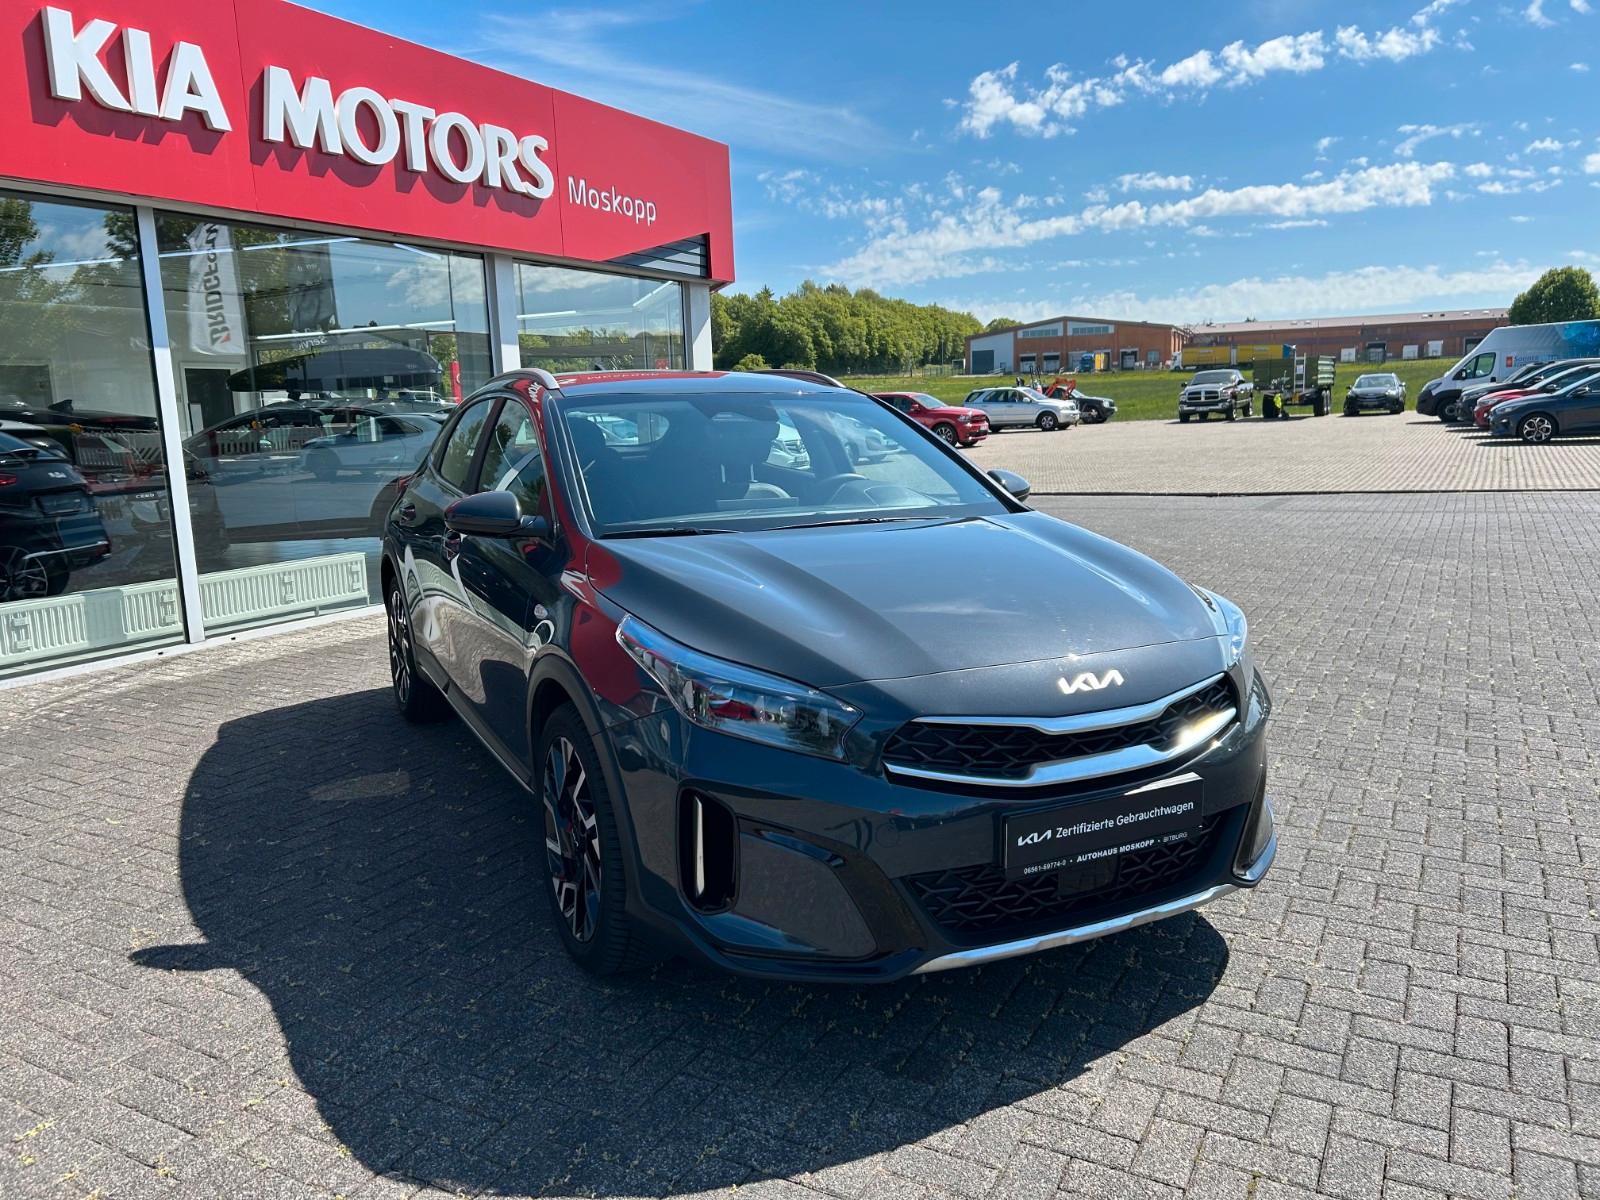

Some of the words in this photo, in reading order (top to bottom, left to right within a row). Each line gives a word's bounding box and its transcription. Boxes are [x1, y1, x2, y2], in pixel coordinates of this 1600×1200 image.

[41, 6, 232, 132] KIA
[263, 65, 555, 200] MOTORS
[567, 175, 657, 227] Moskopp
[1057, 669, 1125, 695] KIA
[1017, 829, 1052, 847] KIA
[1055, 817, 1115, 839] Zertifizierte
[1116, 800, 1195, 827] Gebrauchtwagen
[1076, 847, 1118, 863] AUTOHAUS
[1119, 838, 1155, 853] MOSKOPP
[1162, 831, 1188, 844] BITBURG
